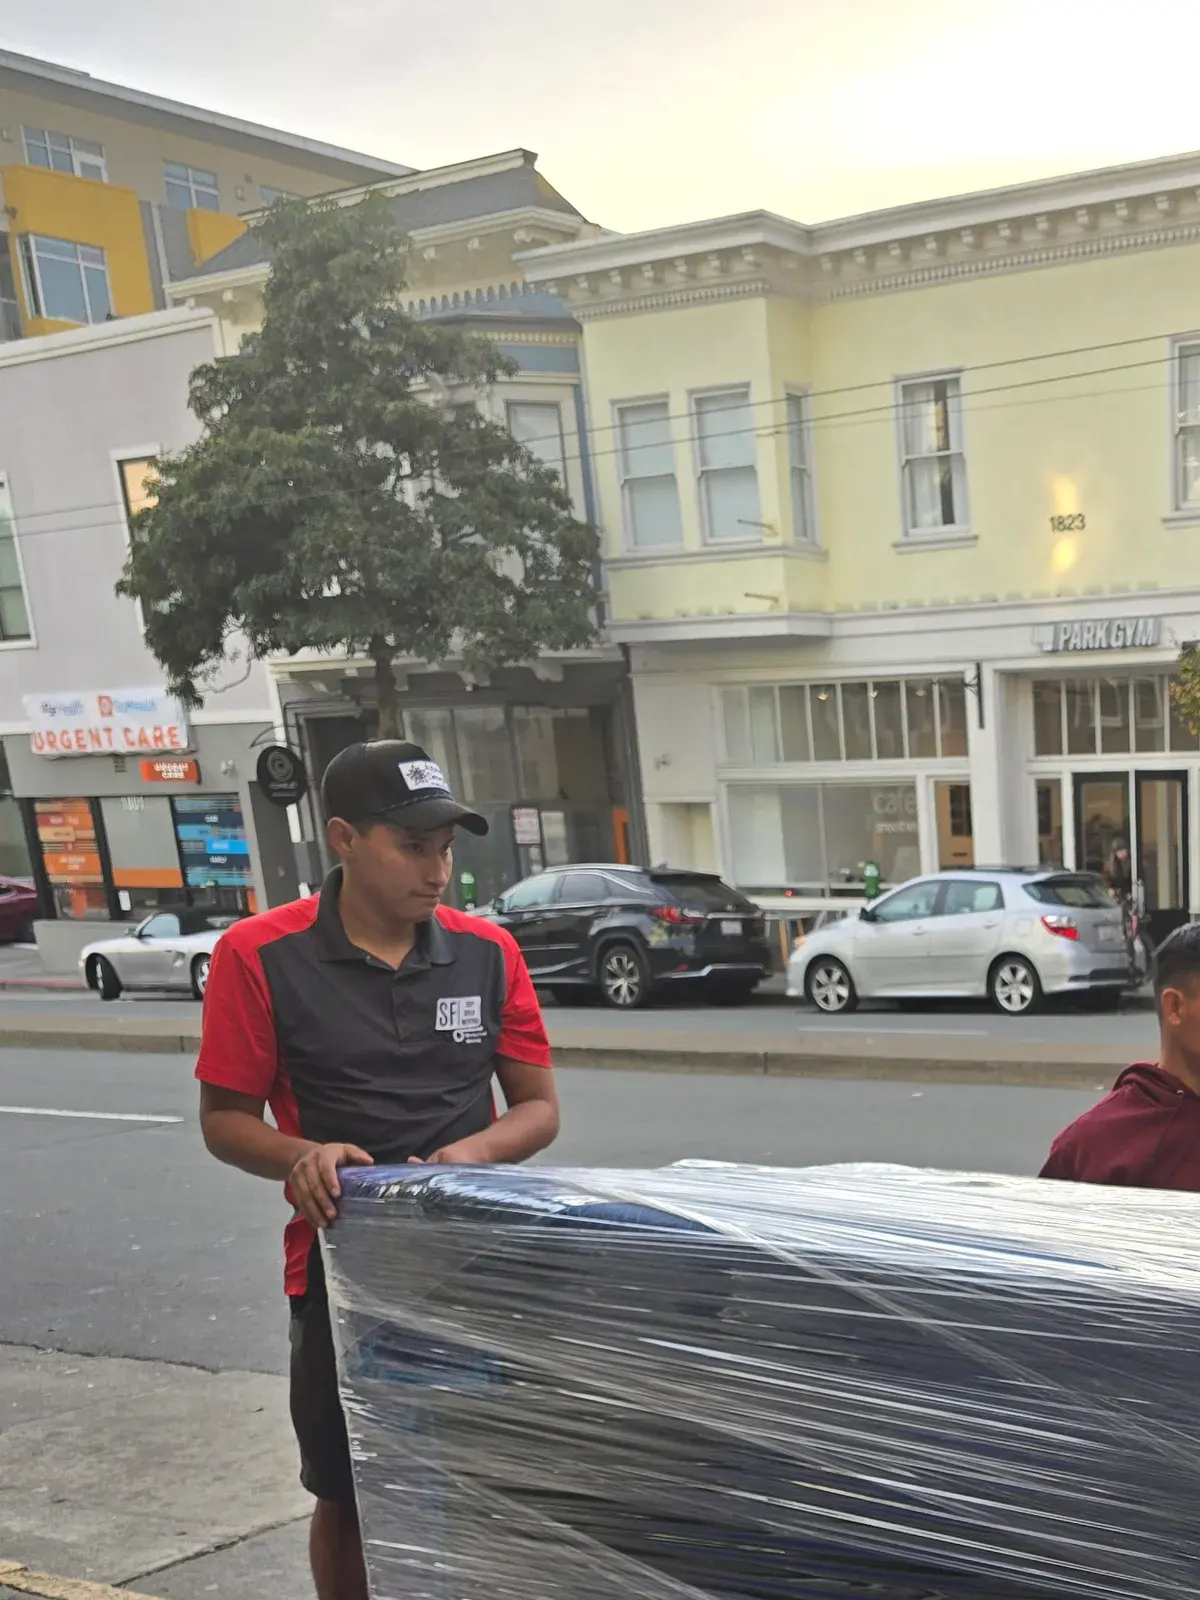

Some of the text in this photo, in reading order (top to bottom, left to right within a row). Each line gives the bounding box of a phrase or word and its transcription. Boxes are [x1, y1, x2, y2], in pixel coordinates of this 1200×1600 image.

[1049, 513, 1086, 533] 1823
[1059, 617, 1160, 650] PARK GYM
[33, 726, 181, 750] URGENT CARE
[440, 1001, 457, 1026] SF
